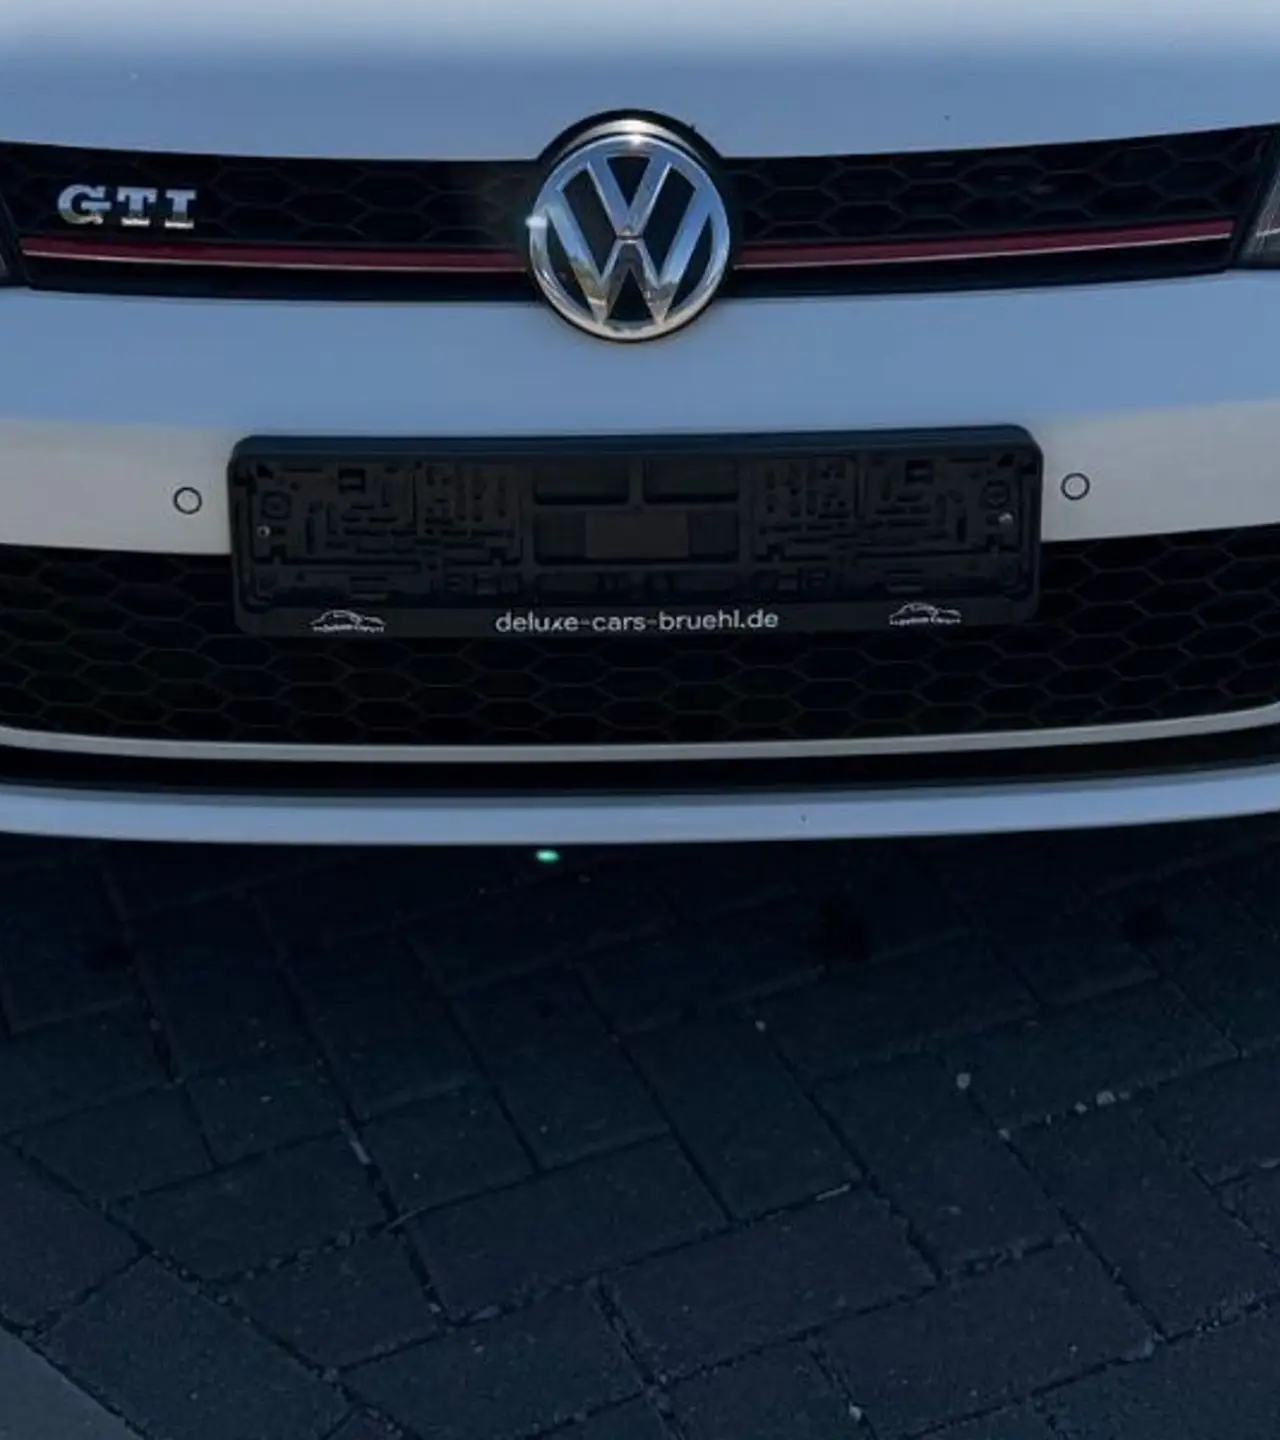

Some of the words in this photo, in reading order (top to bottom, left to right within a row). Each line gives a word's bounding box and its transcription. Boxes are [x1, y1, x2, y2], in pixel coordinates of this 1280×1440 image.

[57, 182, 196, 230] GTI
[536, 144, 724, 334] VW
[494, 608, 779, 633] deluxe-cars-bruehl.de
